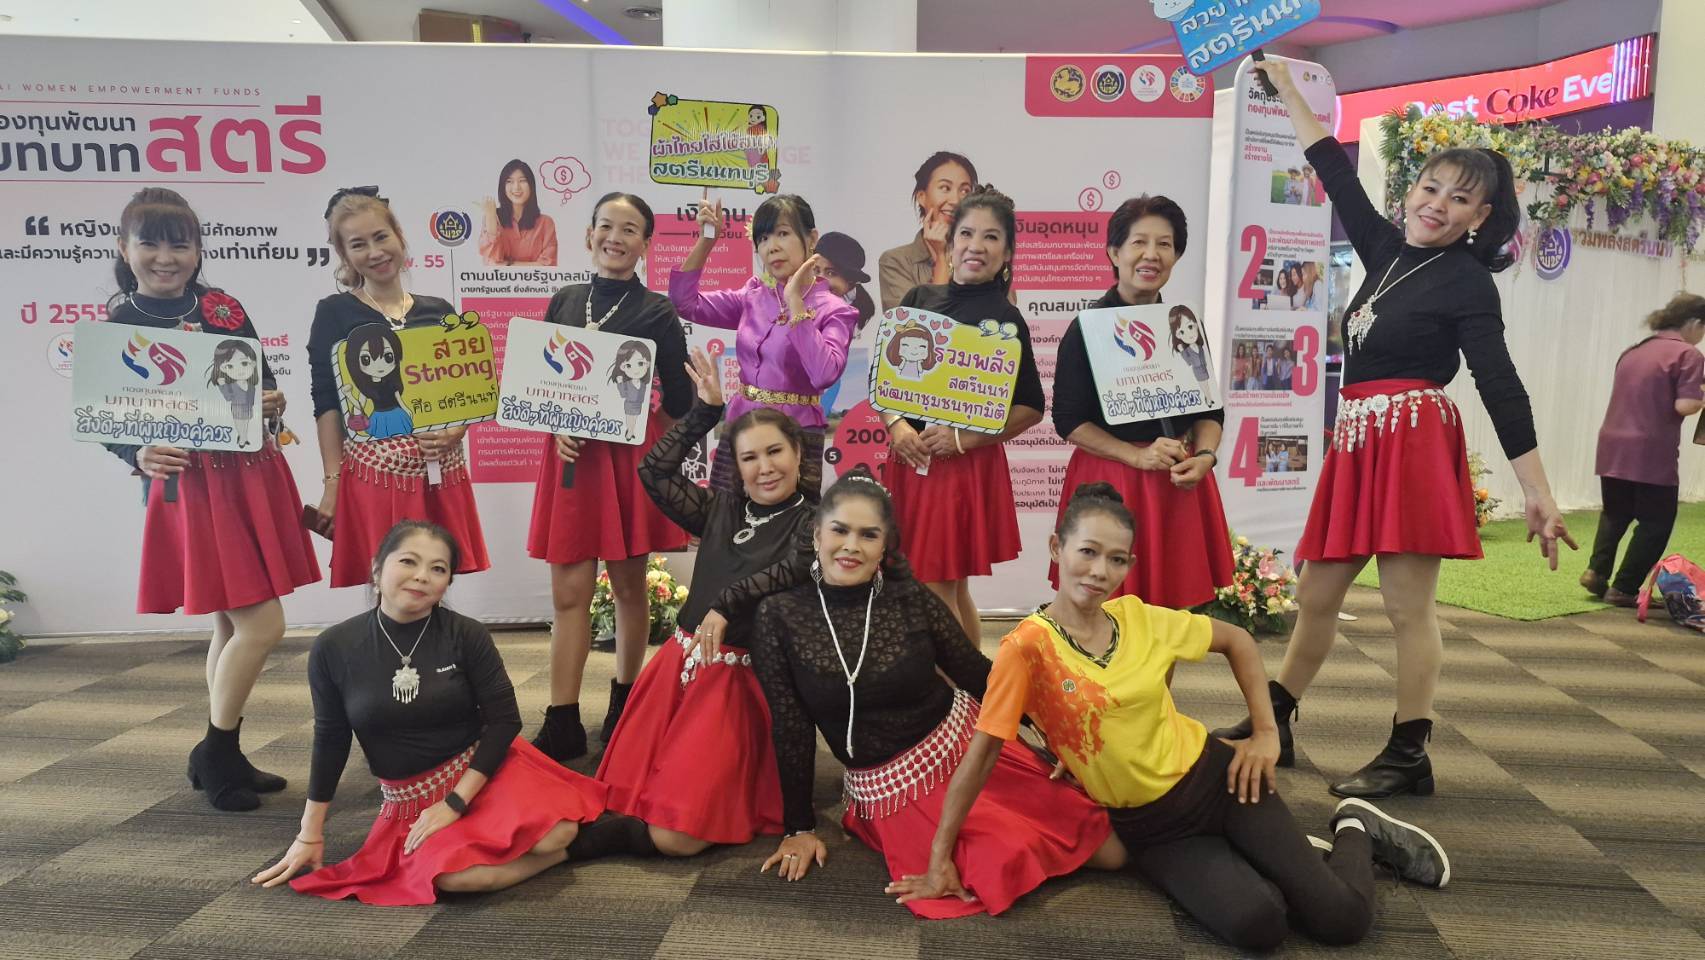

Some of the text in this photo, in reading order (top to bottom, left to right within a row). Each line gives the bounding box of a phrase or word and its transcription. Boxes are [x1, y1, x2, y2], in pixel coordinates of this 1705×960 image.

[1188, 0, 1302, 69] สตรีนน
[22, 83, 77, 92] WOMEN
[88, 85, 203, 96] EMPOWERMENT
[214, 88, 262, 98] FUNDS
[1486, 86, 1558, 115] Coke
[0, 111, 136, 137] องทุนพัฒนา
[654, 160, 767, 187] สตรีนนทบุรี
[1016, 219, 1099, 239] งินอุดหนุน
[201, 242, 298, 260] างเท่าเทียม
[425, 255, 444, 268] 55
[1238, 225, 1267, 299] 2
[21, 302, 37, 324] ปี
[433, 337, 486, 360] สวย
[935, 346, 1015, 375] รวมพลัง
[405, 359, 494, 385] Strong
[1292, 326, 1319, 397] 3
[949, 376, 1009, 399] สตรีนนท์
[411, 398, 432, 414] คือ
[878, 381, 1006, 421] พัฒนาชุมชนทุกมิติ
[846, 429, 889, 446] 200,
[829, 452, 837, 461] 5
[1229, 417, 1263, 487] 4
